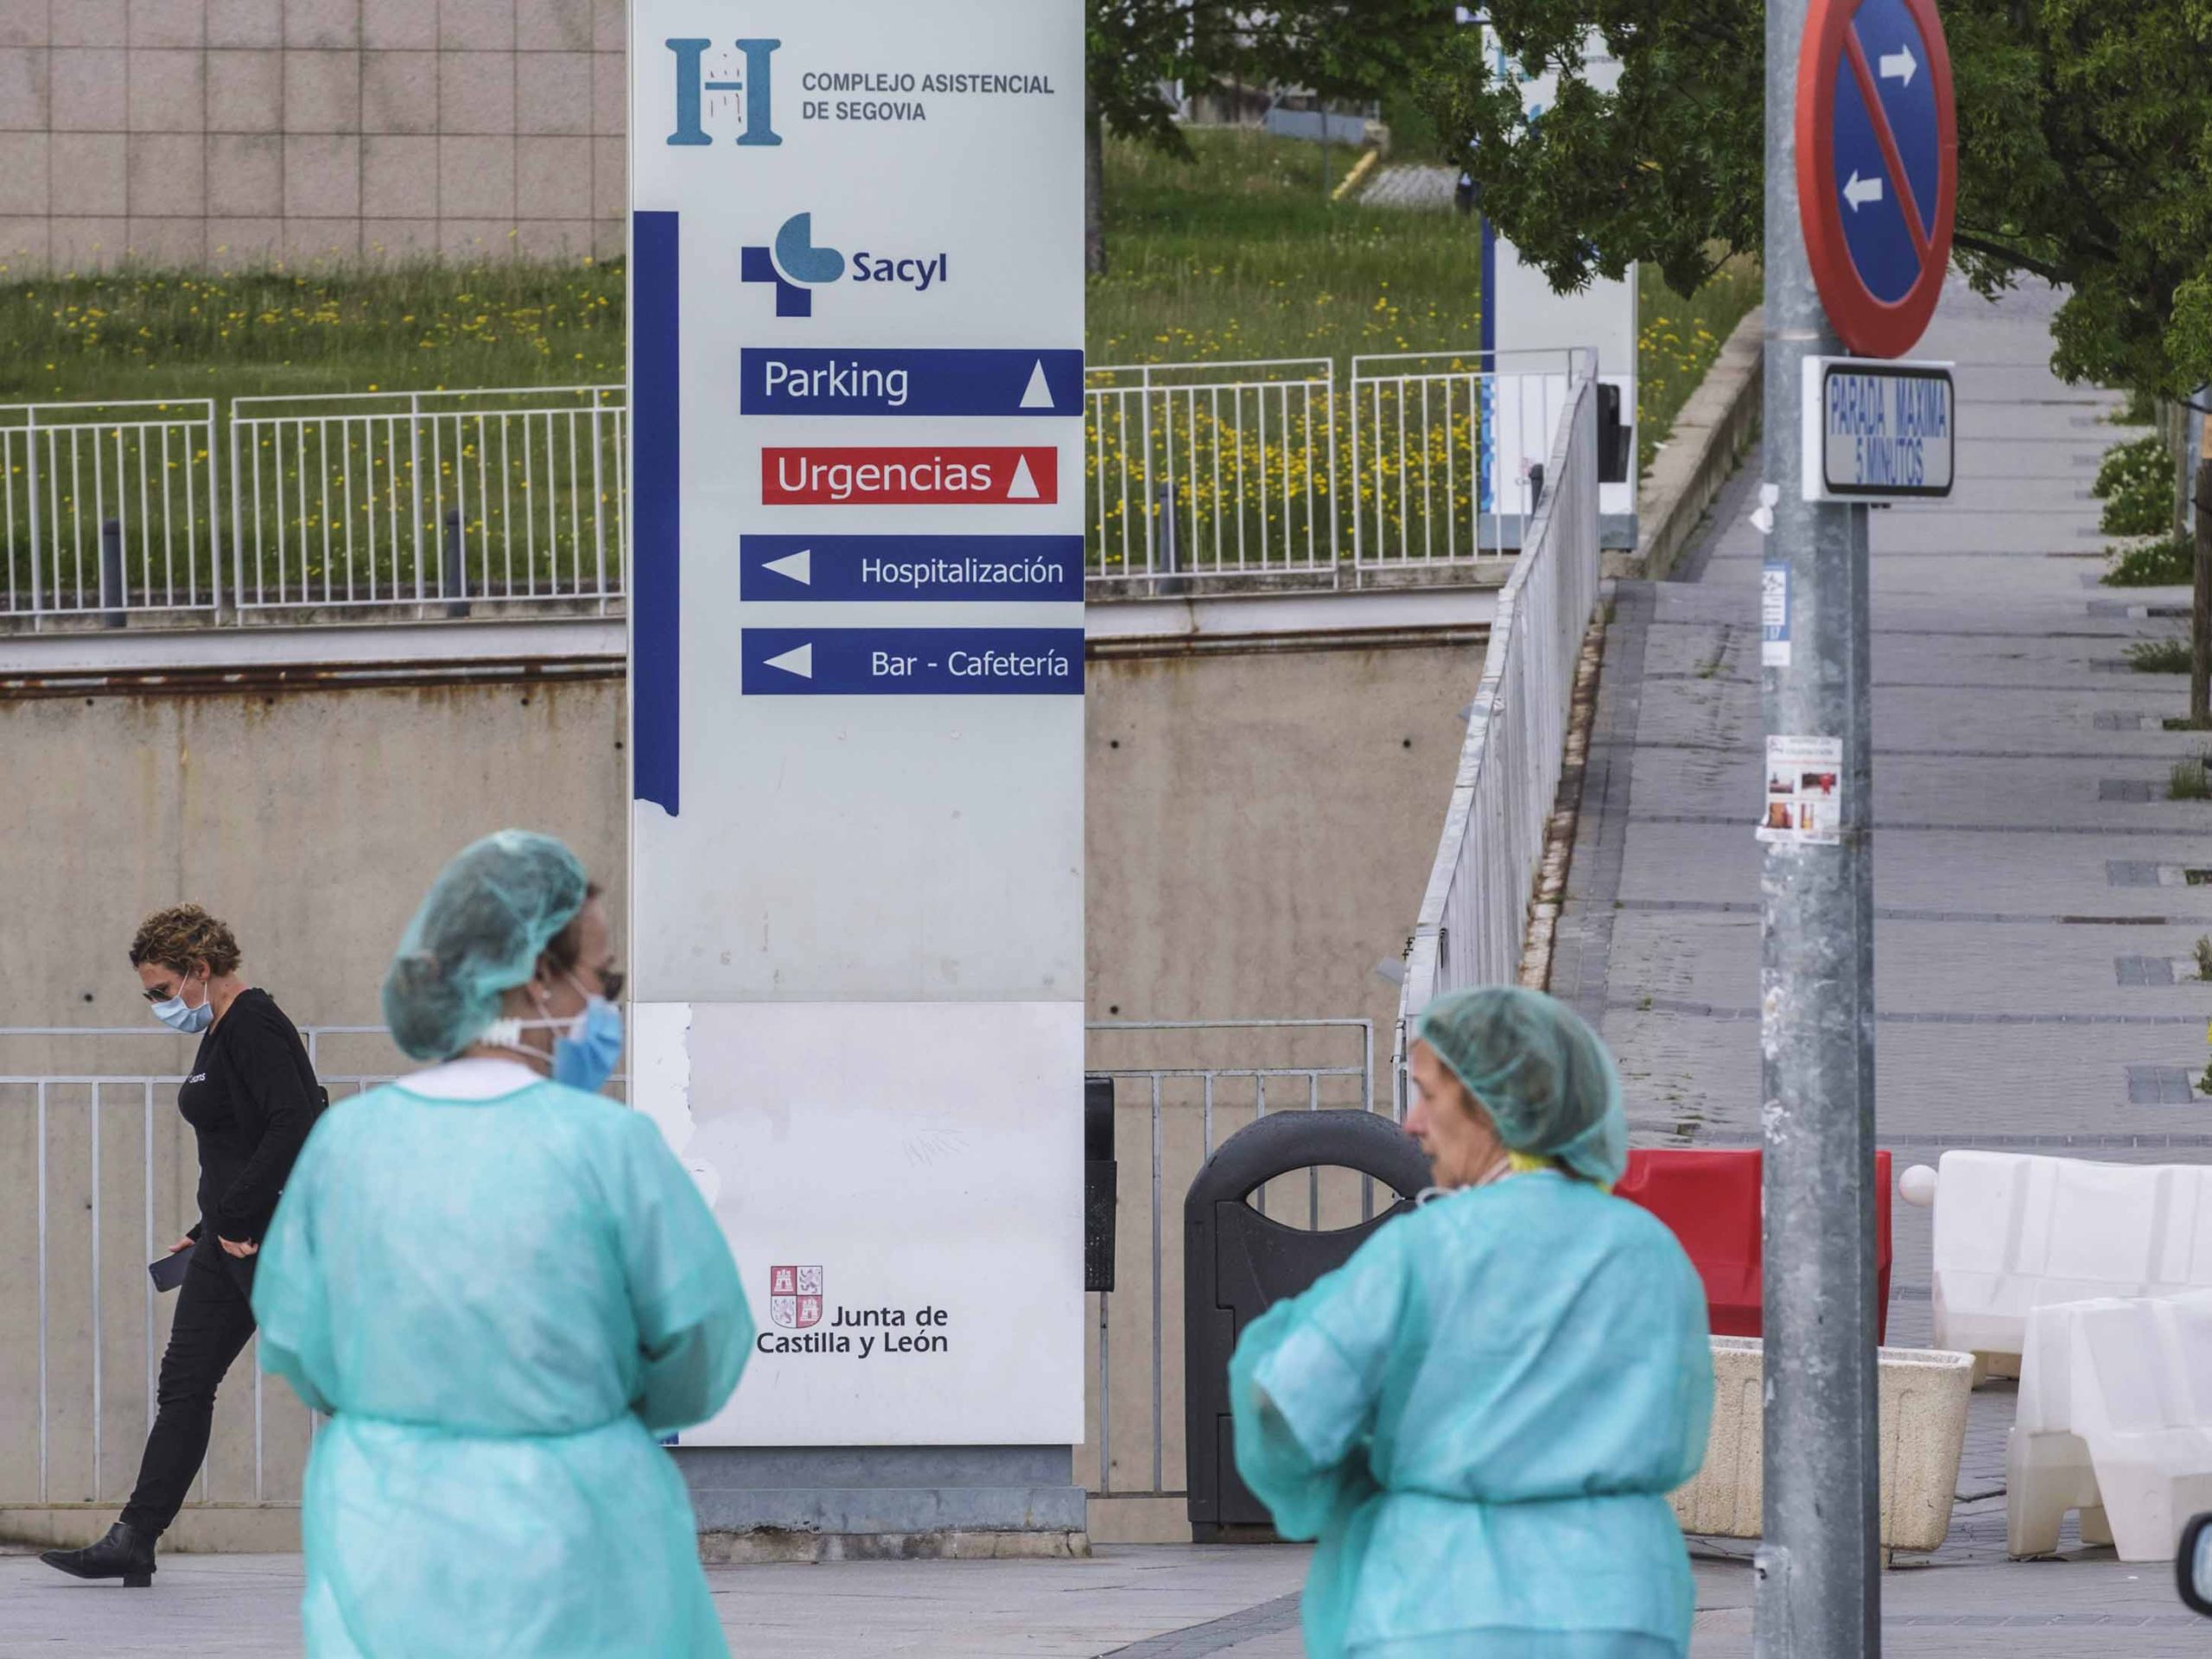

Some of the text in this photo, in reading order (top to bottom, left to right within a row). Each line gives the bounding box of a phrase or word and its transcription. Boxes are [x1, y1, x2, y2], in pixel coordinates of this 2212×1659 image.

[664, 38, 783, 146] H
[802, 72, 1055, 94] COMPLEJO ASISTENCIAL
[802, 101, 926, 121] DE SEGOVIA
[852, 251, 947, 291] Sacyl
[765, 360, 909, 406] Parking
[1831, 376, 1886, 435] PARADA
[778, 456, 992, 499] Urgencias
[1856, 437, 1923, 486] 5 MINUTOS
[861, 556, 1064, 589] Hospitalización
[872, 652, 918, 677] Bar
[948, 648, 1069, 677] Cafetería
[830, 1306, 948, 1327] Junta de
[756, 1329, 948, 1359] Castilla y León
